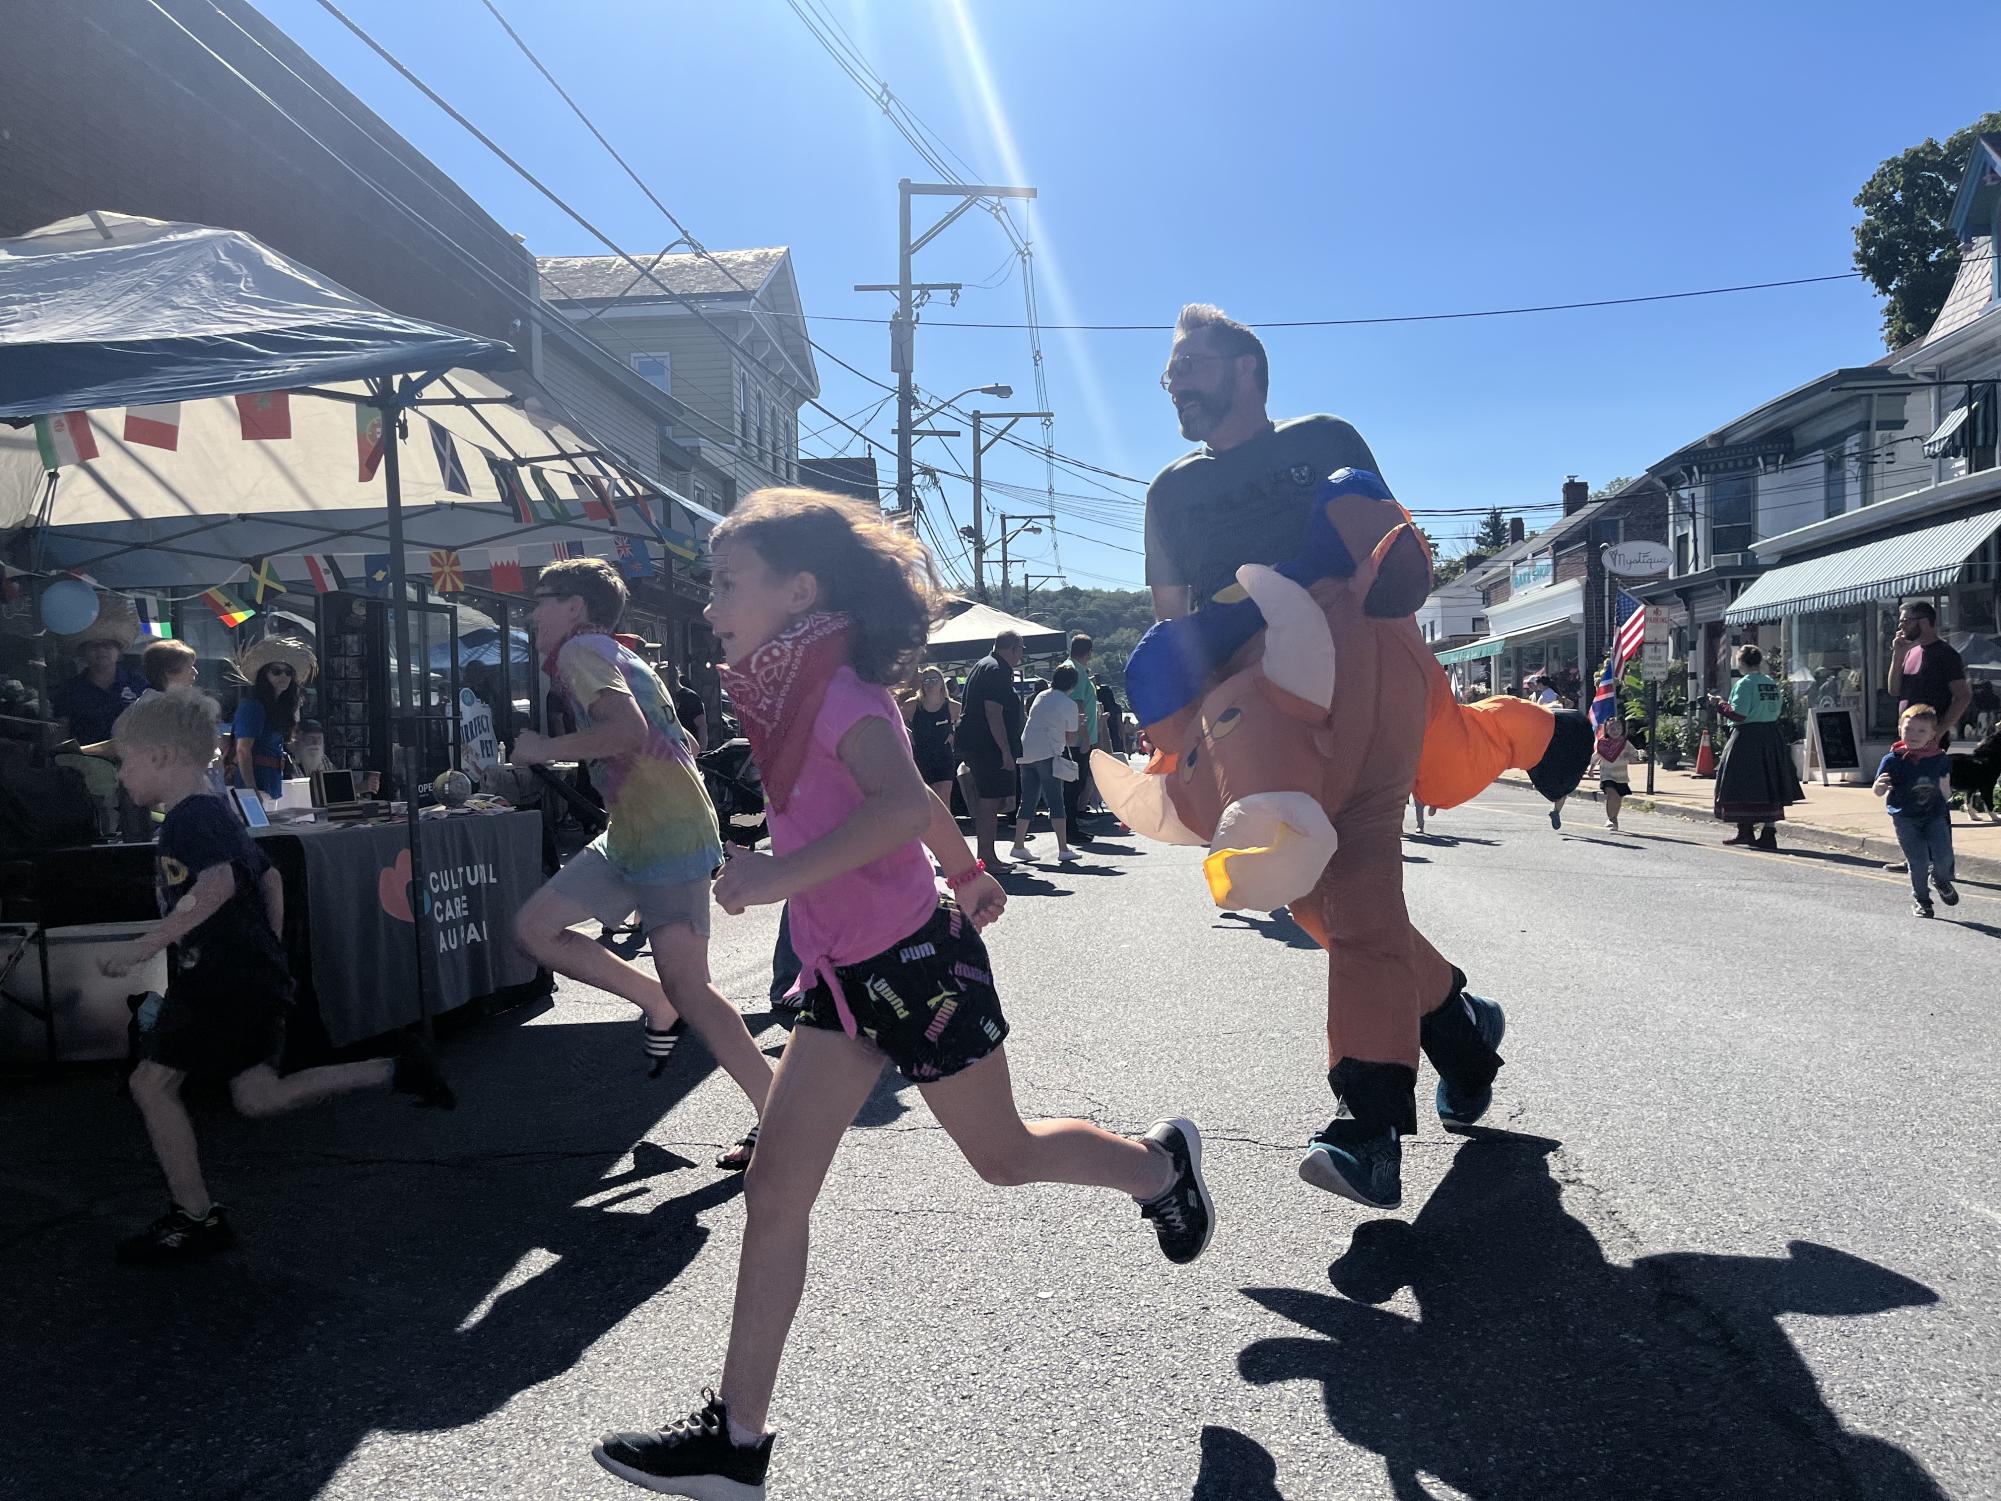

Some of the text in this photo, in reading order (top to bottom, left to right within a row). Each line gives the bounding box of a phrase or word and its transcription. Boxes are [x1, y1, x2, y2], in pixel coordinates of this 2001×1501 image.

[480, 739, 494, 758] PET
[418, 783, 434, 793] OPE
[434, 895, 469, 923] CARE
[440, 928, 459, 954] AU
[900, 942, 936, 963] PUM
[873, 978, 911, 1020] PUMA
[924, 998, 959, 1043] PUMA
